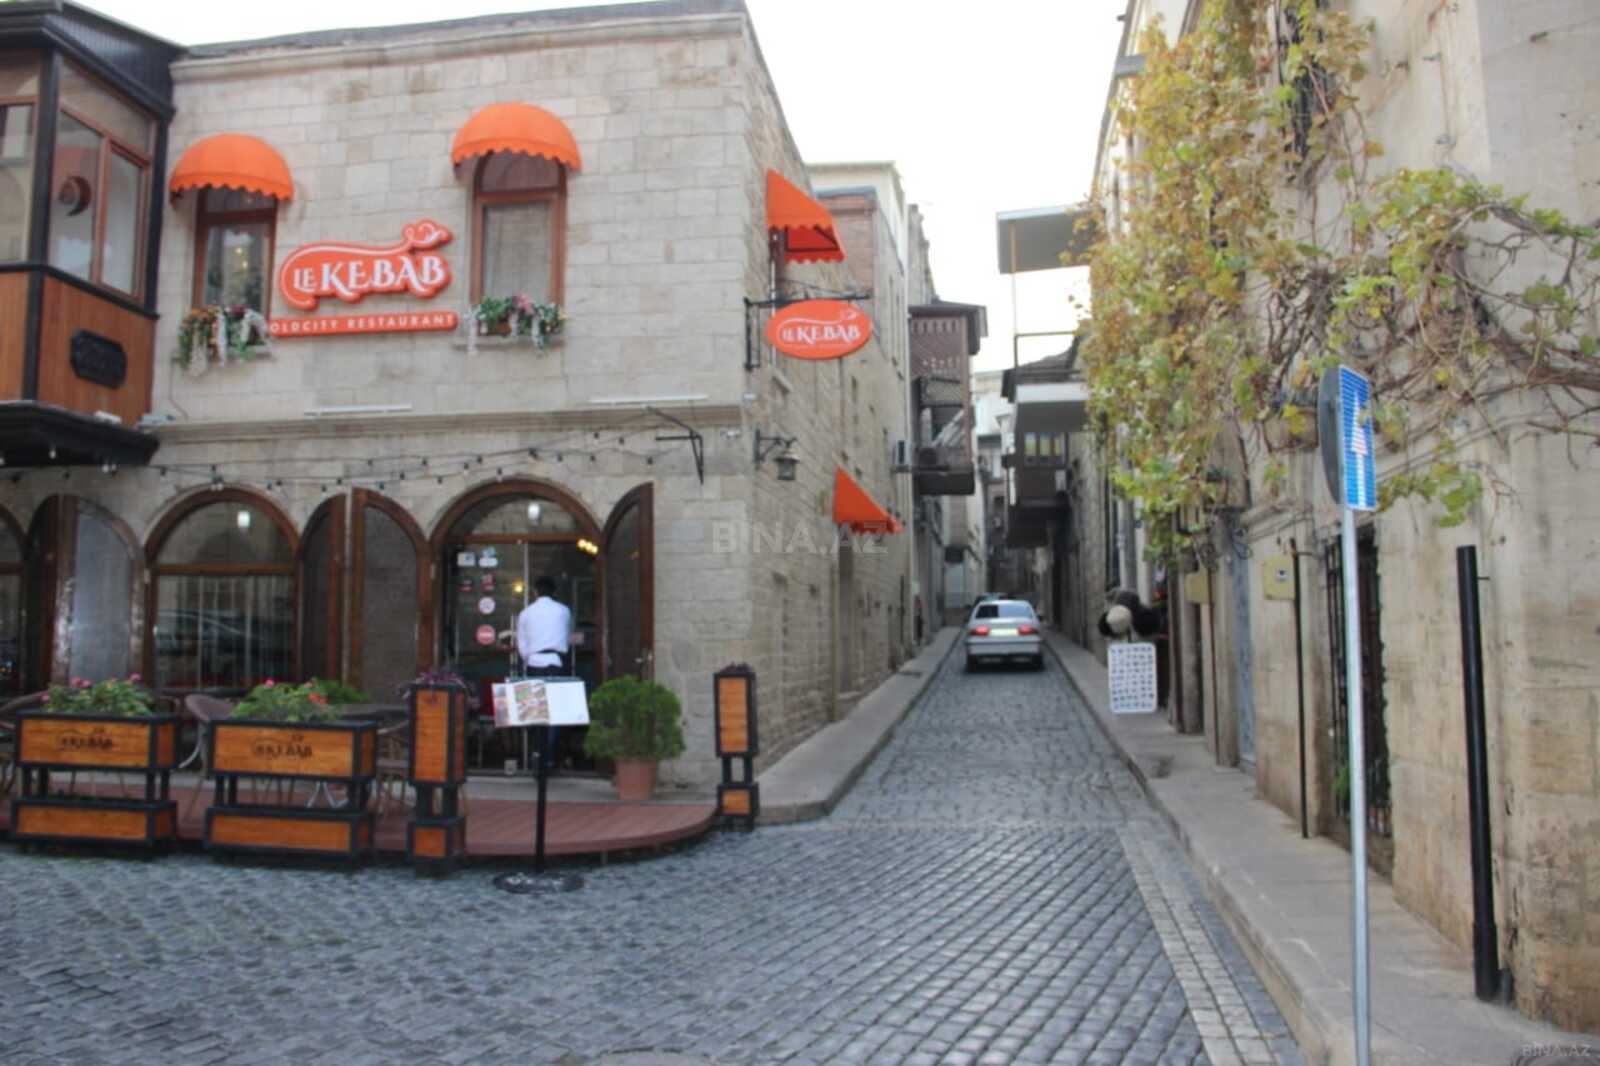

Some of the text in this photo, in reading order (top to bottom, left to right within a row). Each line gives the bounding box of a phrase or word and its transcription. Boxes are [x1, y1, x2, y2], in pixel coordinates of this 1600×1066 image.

[294, 256, 444, 295] LE KEBAB
[346, 314, 454, 329] RESTAURANT
[797, 325, 861, 344] KEBAB
